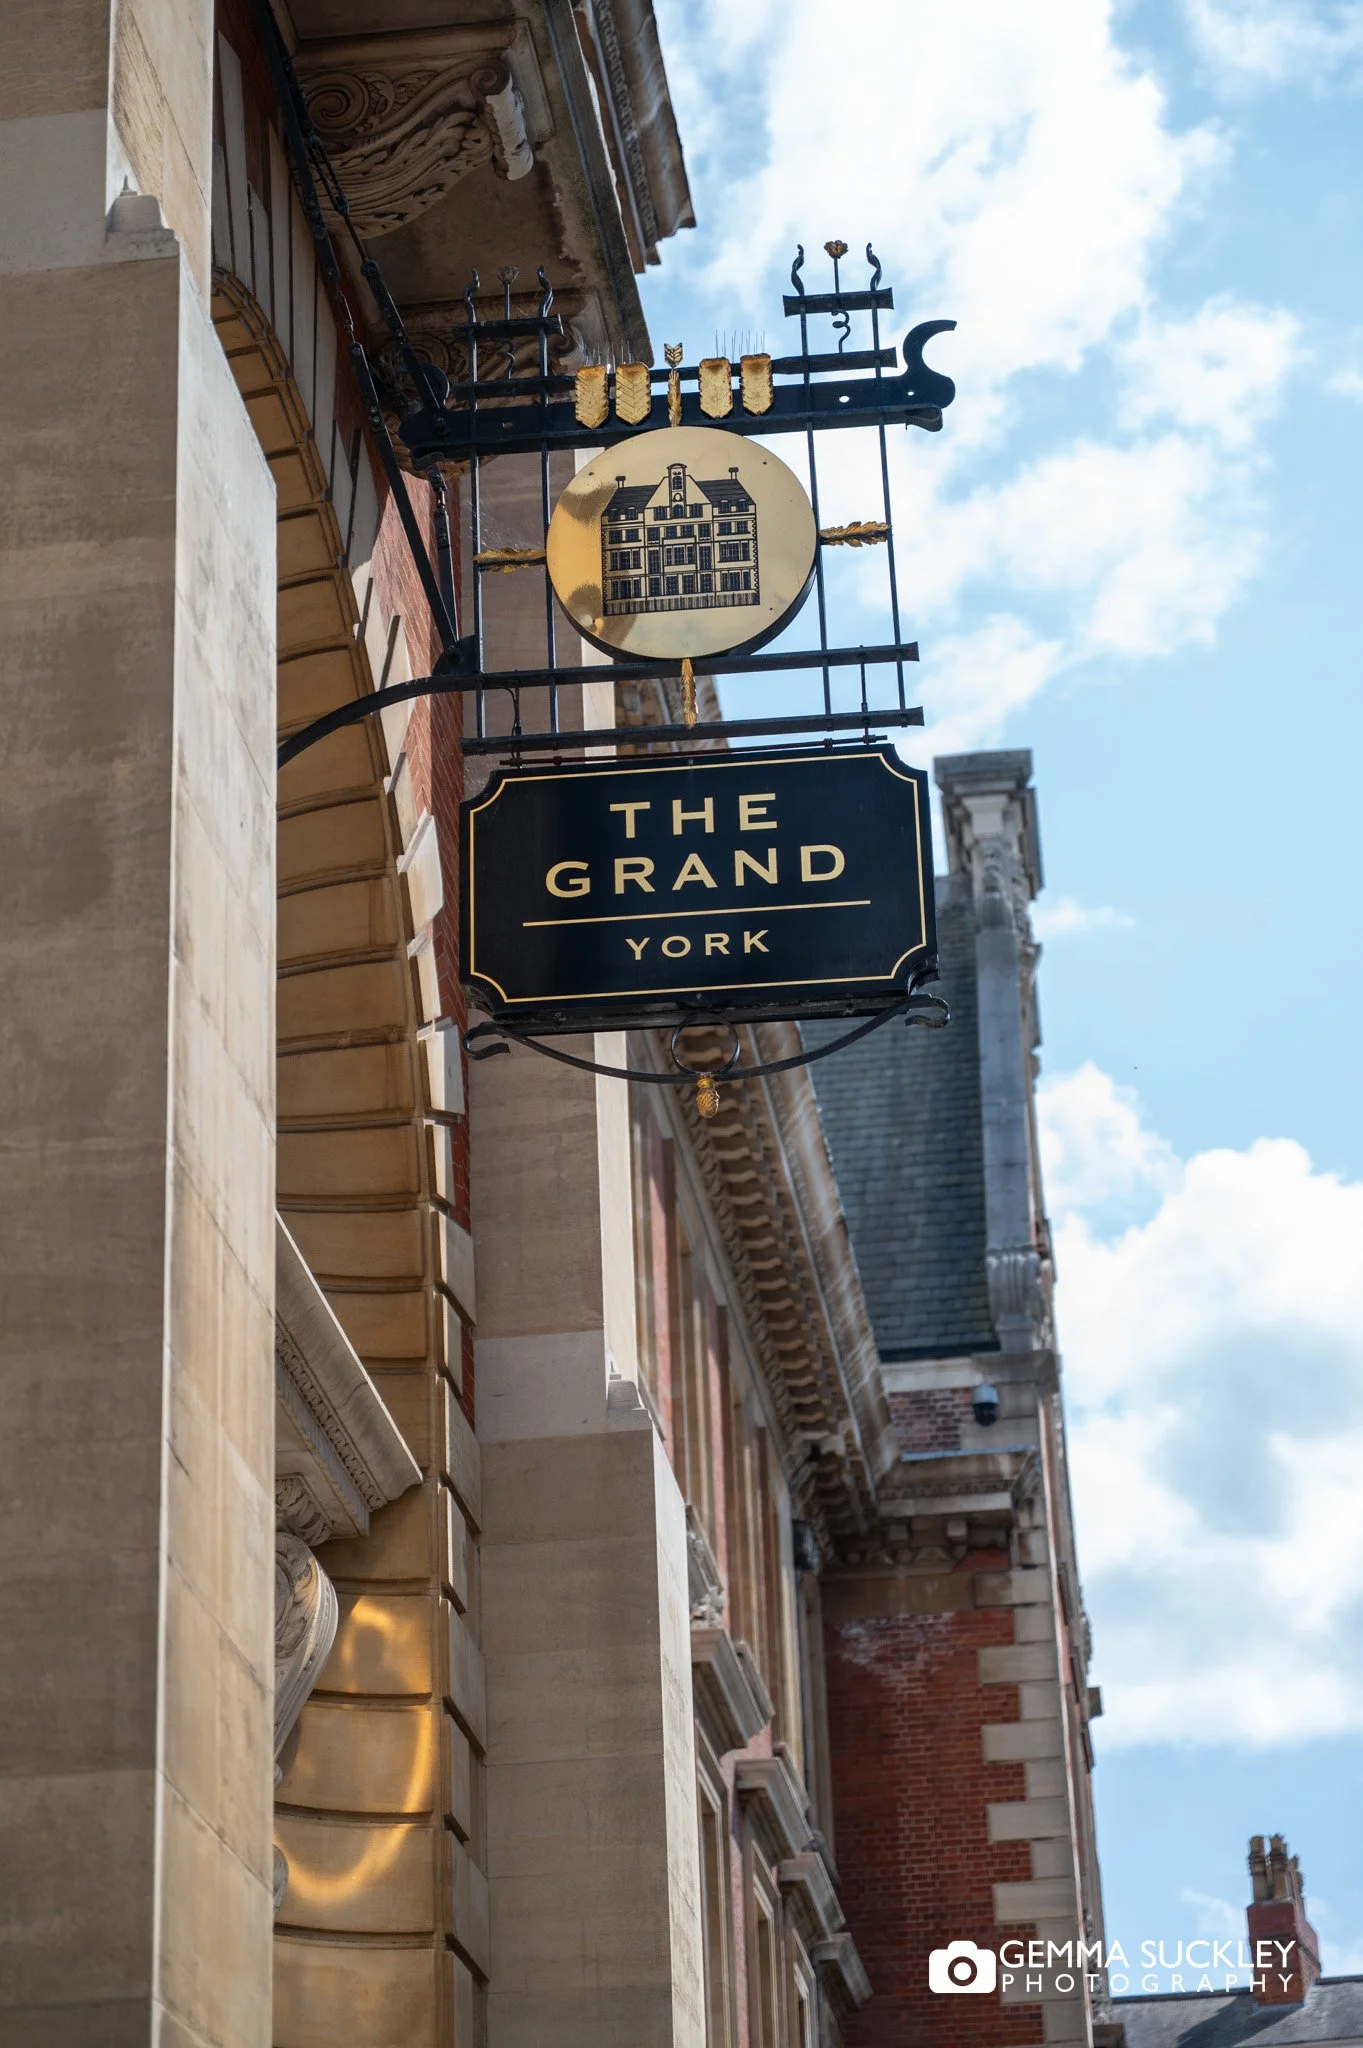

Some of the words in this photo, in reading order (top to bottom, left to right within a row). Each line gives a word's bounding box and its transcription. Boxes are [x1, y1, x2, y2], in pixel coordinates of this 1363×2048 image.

[609, 792, 779, 839] THE
[545, 844, 846, 898] GRAND
[625, 929, 770, 961] YORK
